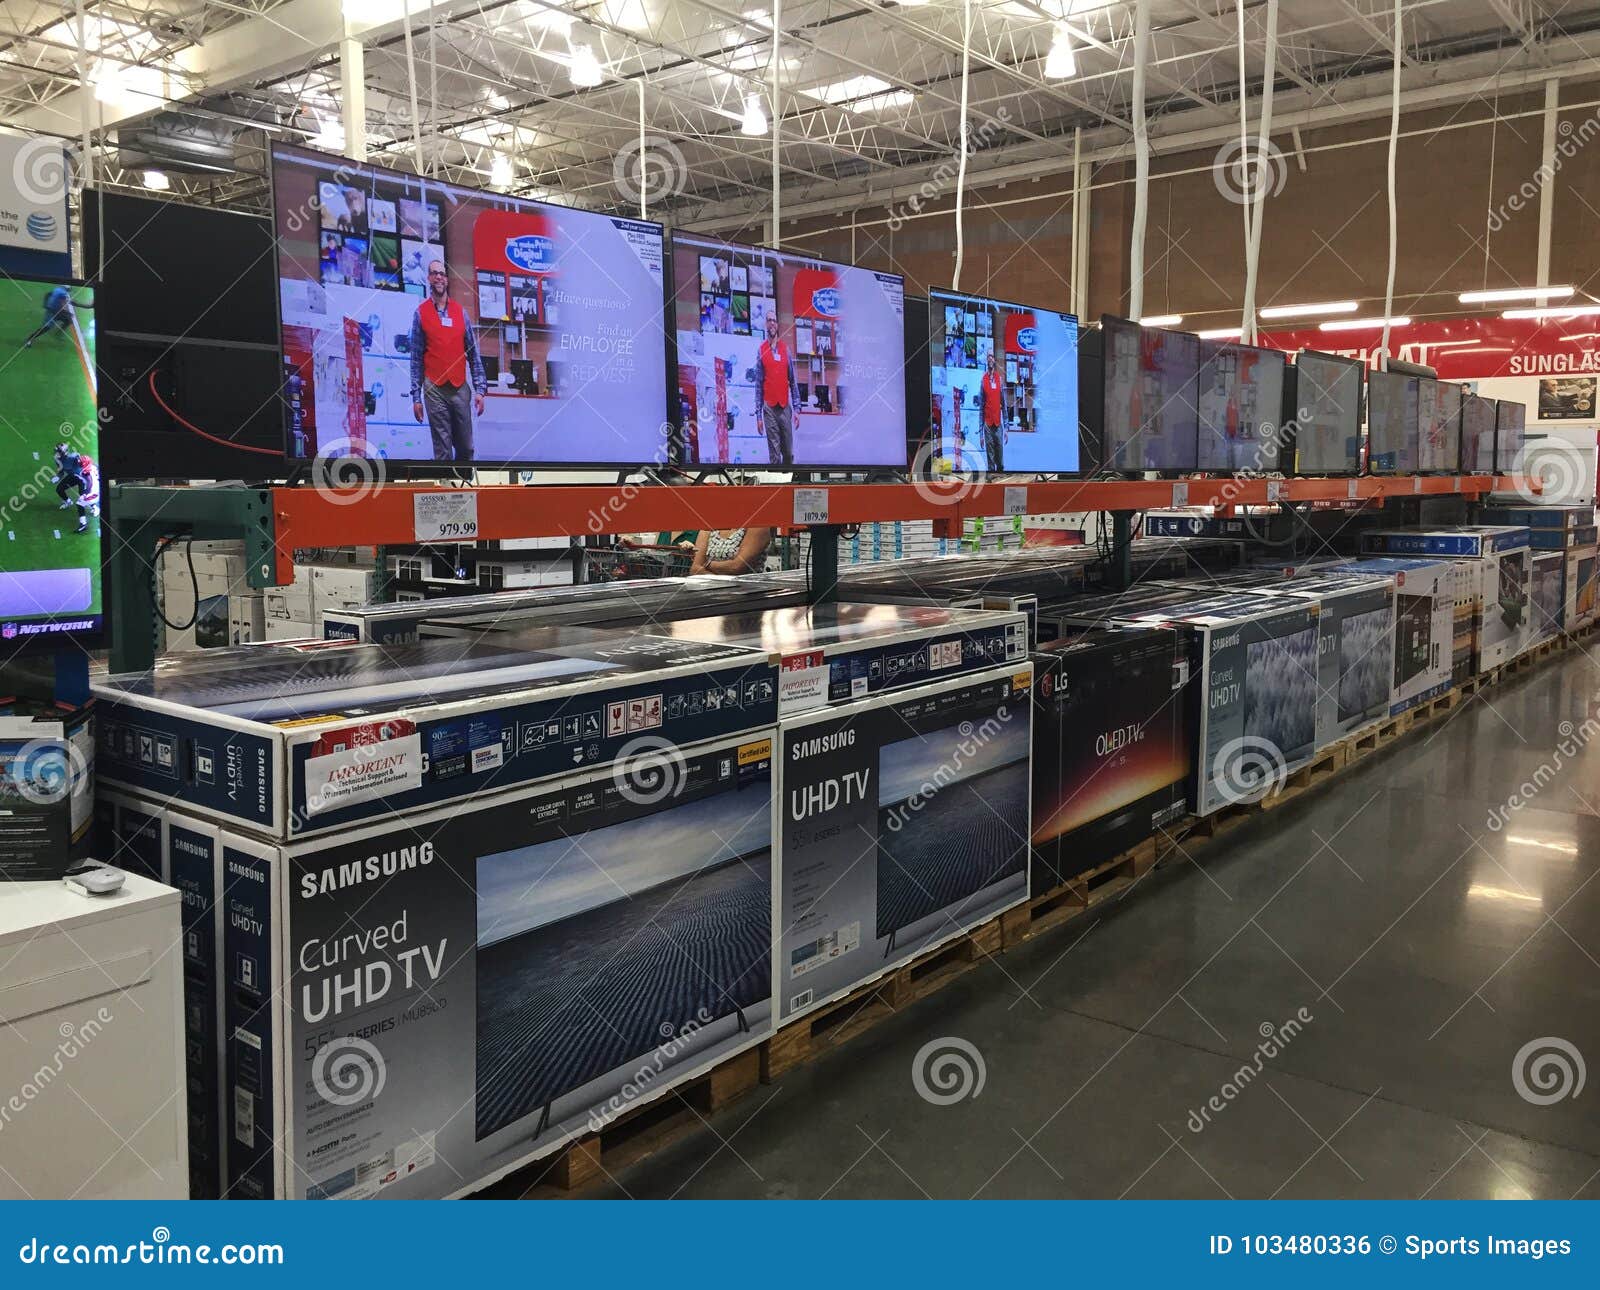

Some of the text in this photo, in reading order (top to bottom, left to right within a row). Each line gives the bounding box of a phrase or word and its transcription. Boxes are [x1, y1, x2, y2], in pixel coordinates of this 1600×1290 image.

[513, 247, 543, 261] Digital
[561, 333, 633, 355] EMPLOYEE
[804, 511, 828, 522] 1079.99
[440, 522, 476, 536] 979.99
[1212, 633, 1240, 650] SAMSUNG
[1055, 672, 1068, 692] LG
[1210, 684, 1229, 709] UHD
[793, 728, 855, 761] SAMSUNG
[1096, 729, 1126, 756] OLED
[235, 746, 244, 788] Curved
[328, 752, 406, 782] IMPORTANT
[367, 770, 389, 780] Support
[257, 747, 267, 813] SAMSUNG
[792, 767, 870, 821] UHD TV
[175, 838, 209, 859] SAMSUNG
[229, 860, 265, 884] SAMSUNG
[301, 841, 434, 899] SAMSUNG
[230, 899, 254, 917] Curved
[231, 913, 263, 937] UHD TV
[300, 909, 408, 972] Curved
[303, 938, 447, 1024] UHD TV
